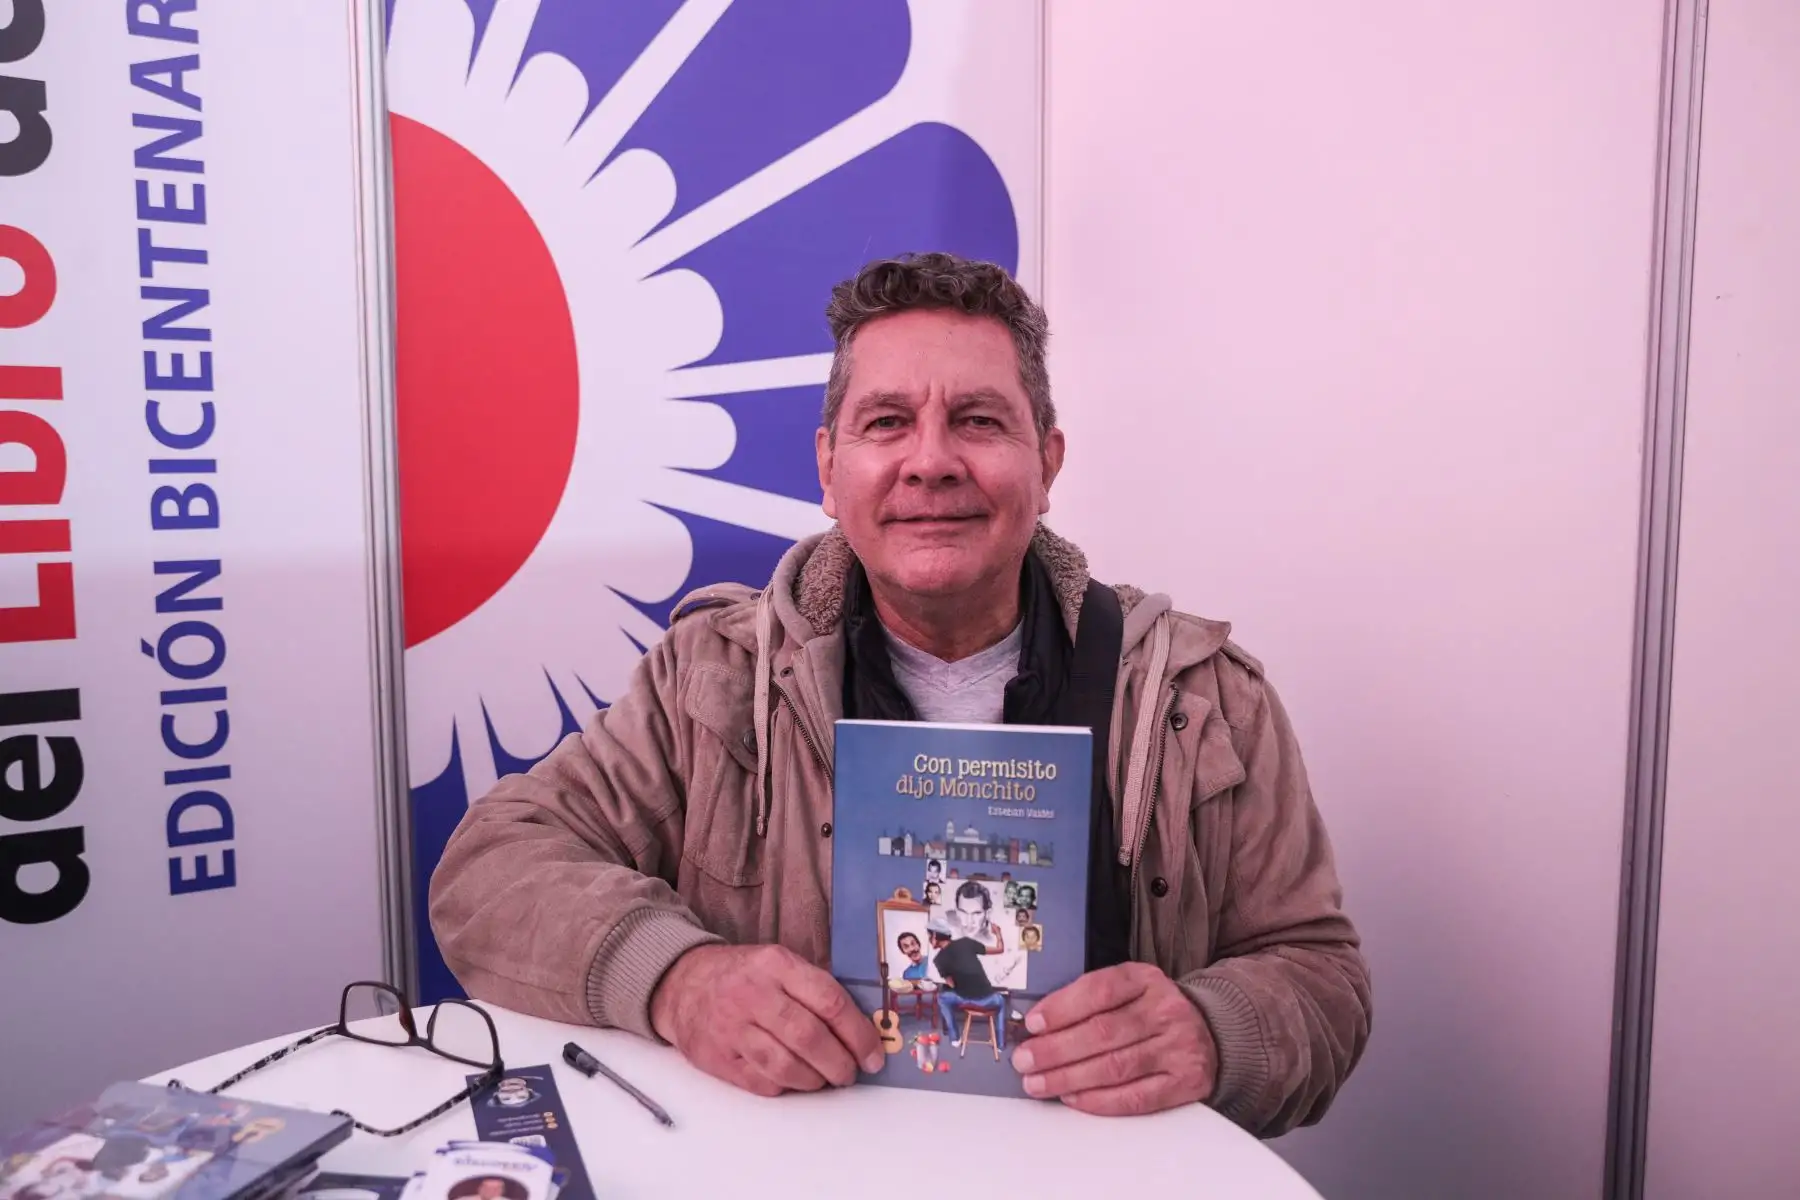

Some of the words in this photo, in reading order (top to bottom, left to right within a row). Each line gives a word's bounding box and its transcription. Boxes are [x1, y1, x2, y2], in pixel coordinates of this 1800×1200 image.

[141, 559, 237, 896] EDICIÓN
[914, 753, 953, 775] Con
[958, 758, 1057, 781] permisito
[895, 774, 934, 800] dijo
[939, 776, 1037, 802] Monchito
